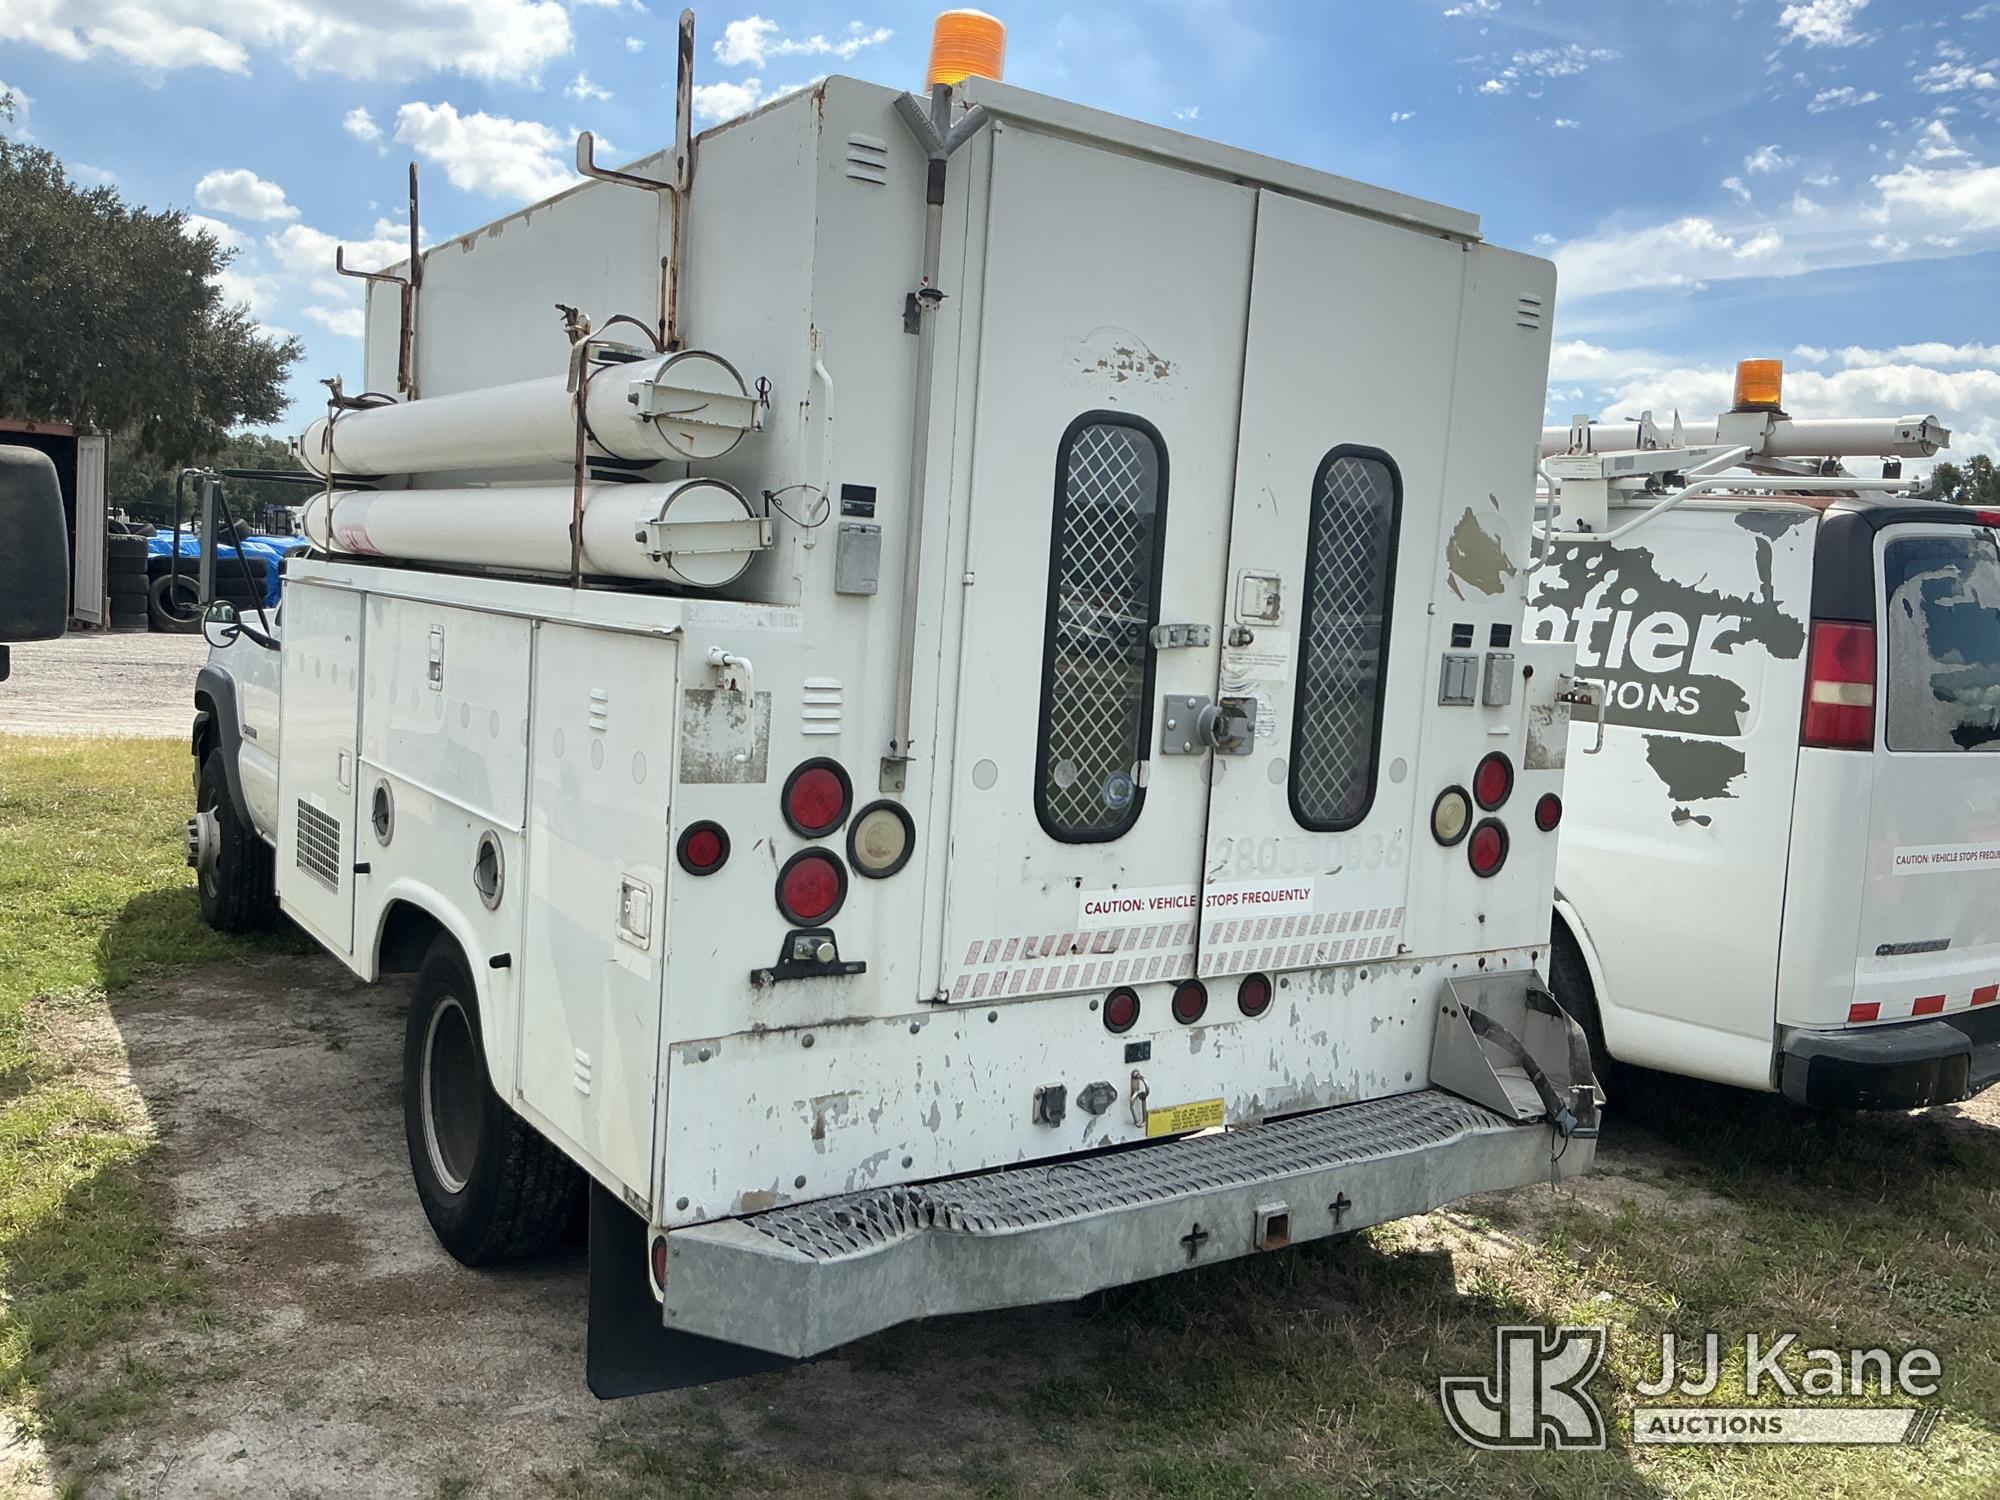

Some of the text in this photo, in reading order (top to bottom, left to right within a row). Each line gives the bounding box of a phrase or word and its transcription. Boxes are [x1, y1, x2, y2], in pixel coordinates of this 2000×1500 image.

[1896, 854, 1930, 865] CAUTION:
[1931, 852, 1958, 863] VEHICLE
[1959, 851, 1978, 861] STOPS
[1084, 888, 1311, 915] CAUTION: VEHICLE STOPS FREQUENTLY
